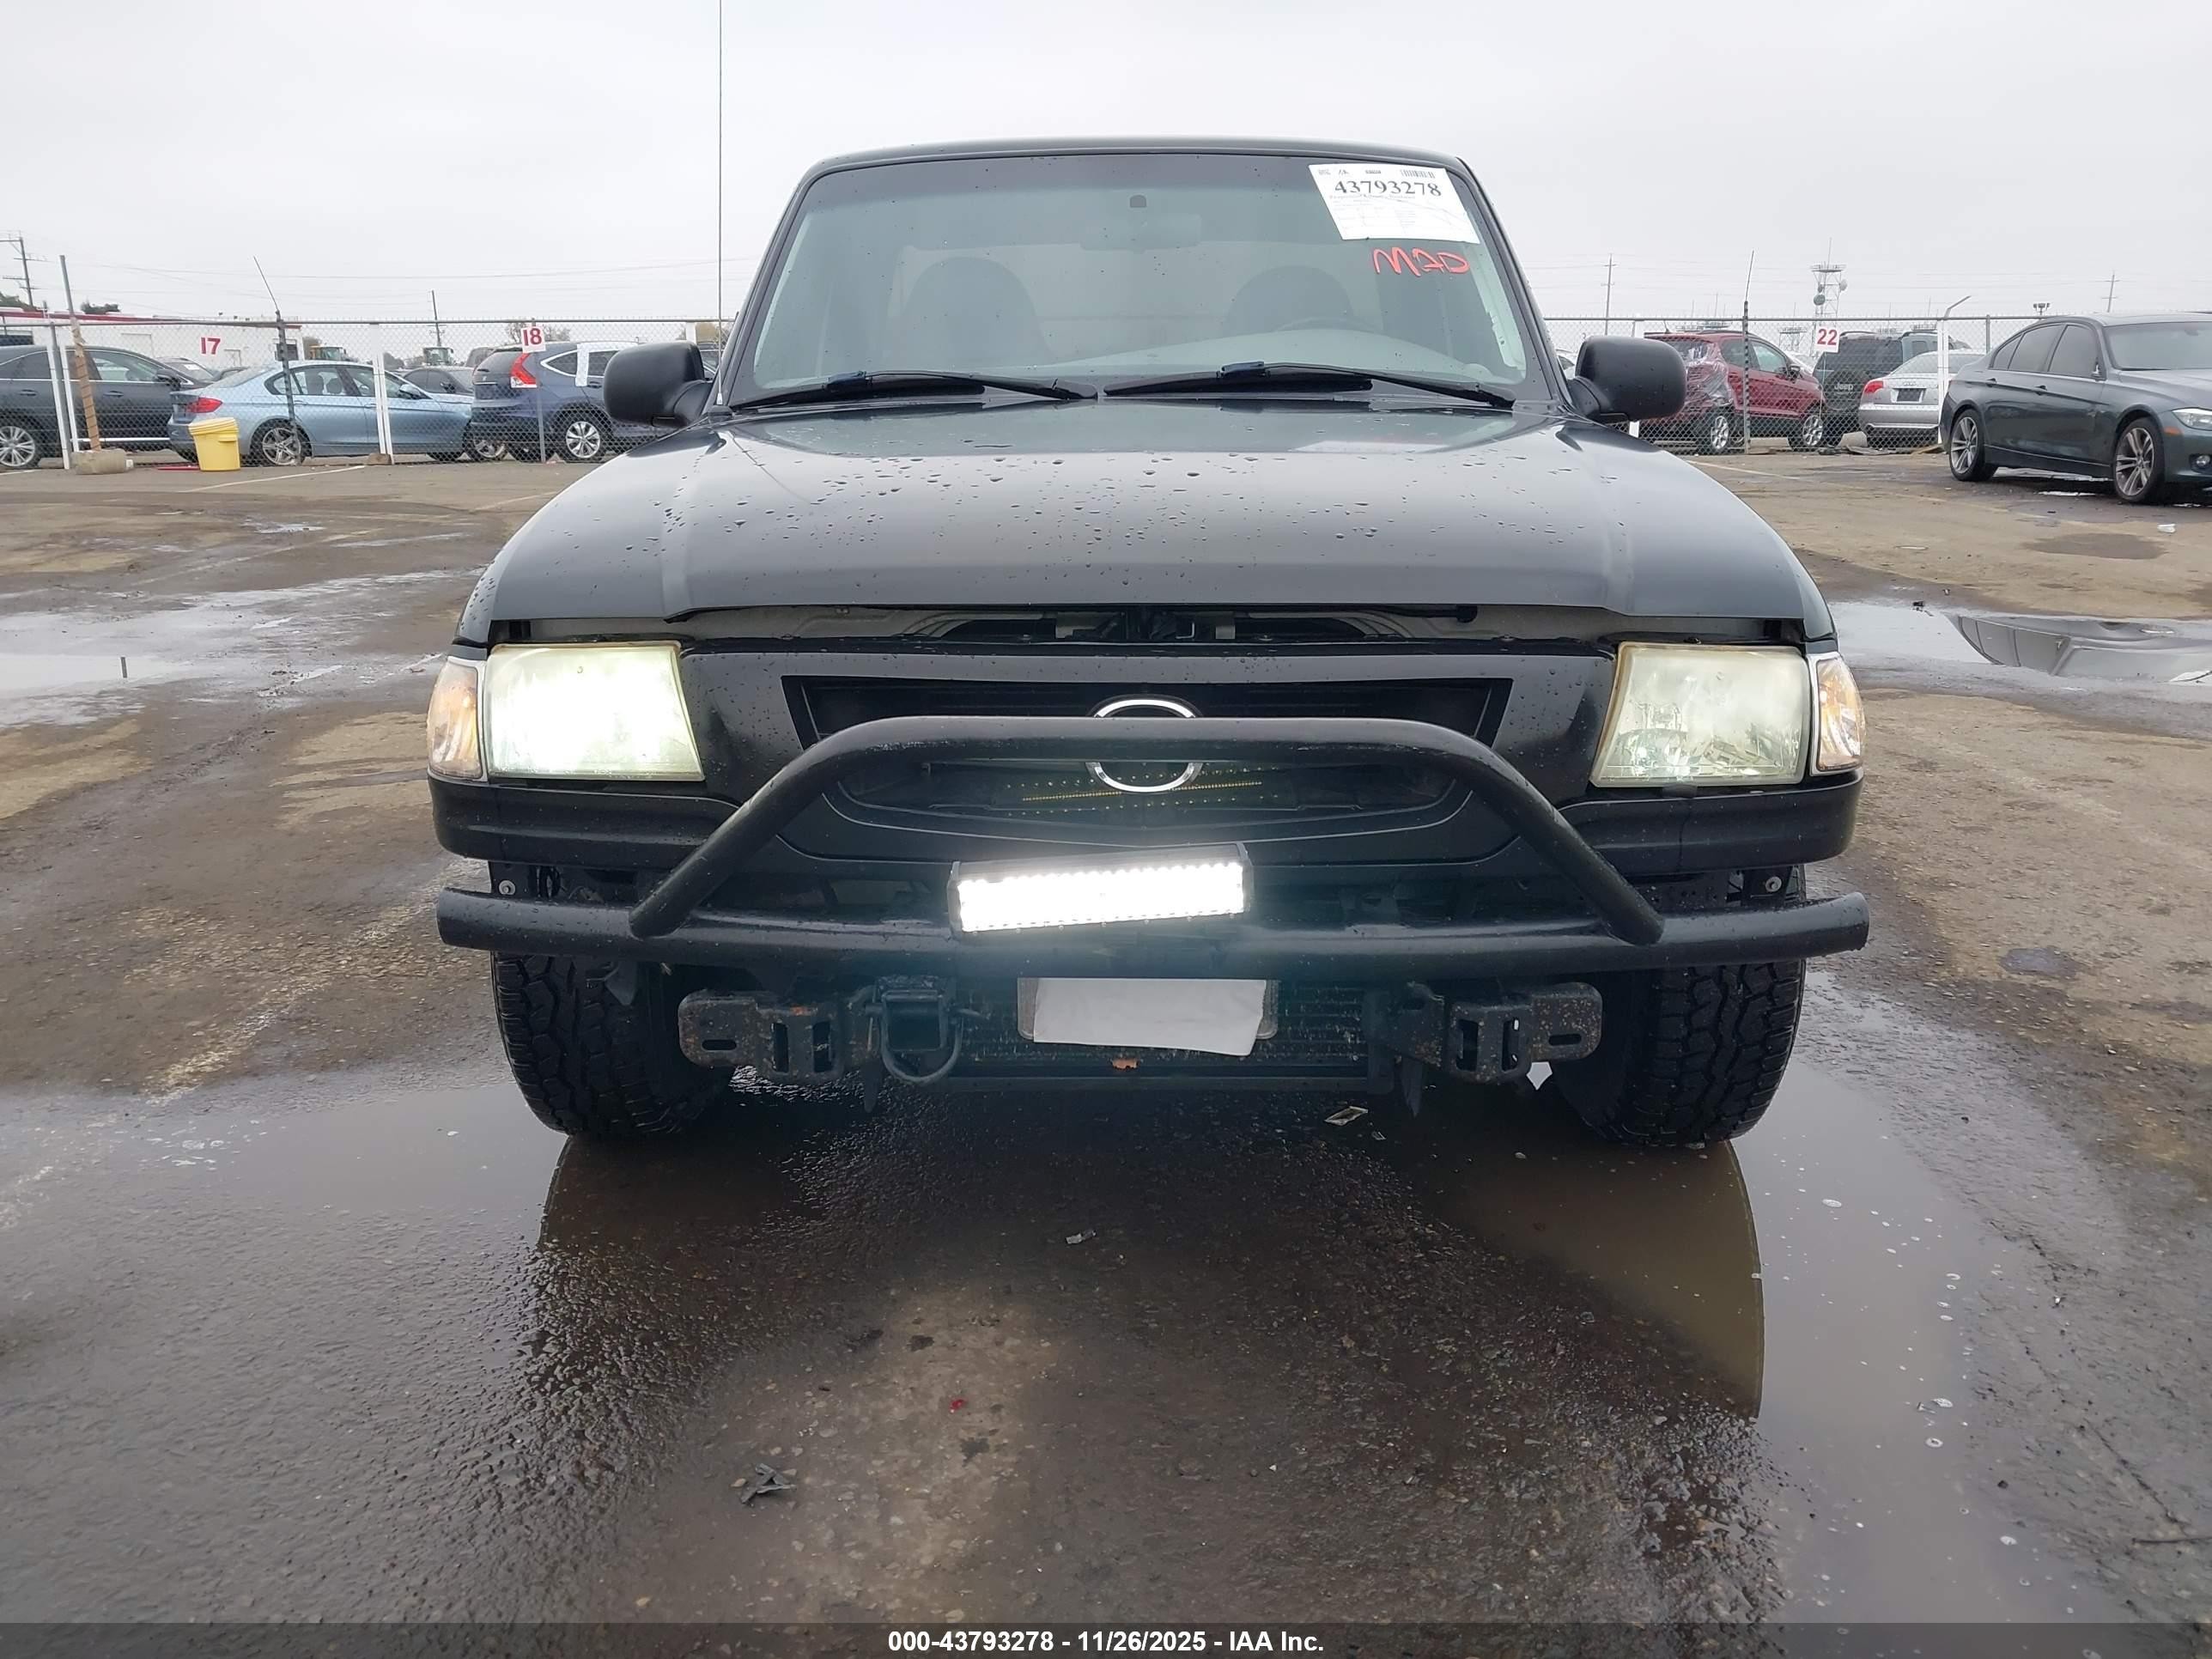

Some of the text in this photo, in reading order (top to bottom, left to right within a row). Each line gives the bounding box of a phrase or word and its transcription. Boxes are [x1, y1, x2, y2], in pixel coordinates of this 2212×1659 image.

[1334, 180, 1442, 197] 43793278
[523, 327, 542, 346] 18
[1817, 328, 1838, 345] 22
[200, 337, 221, 355] 17
